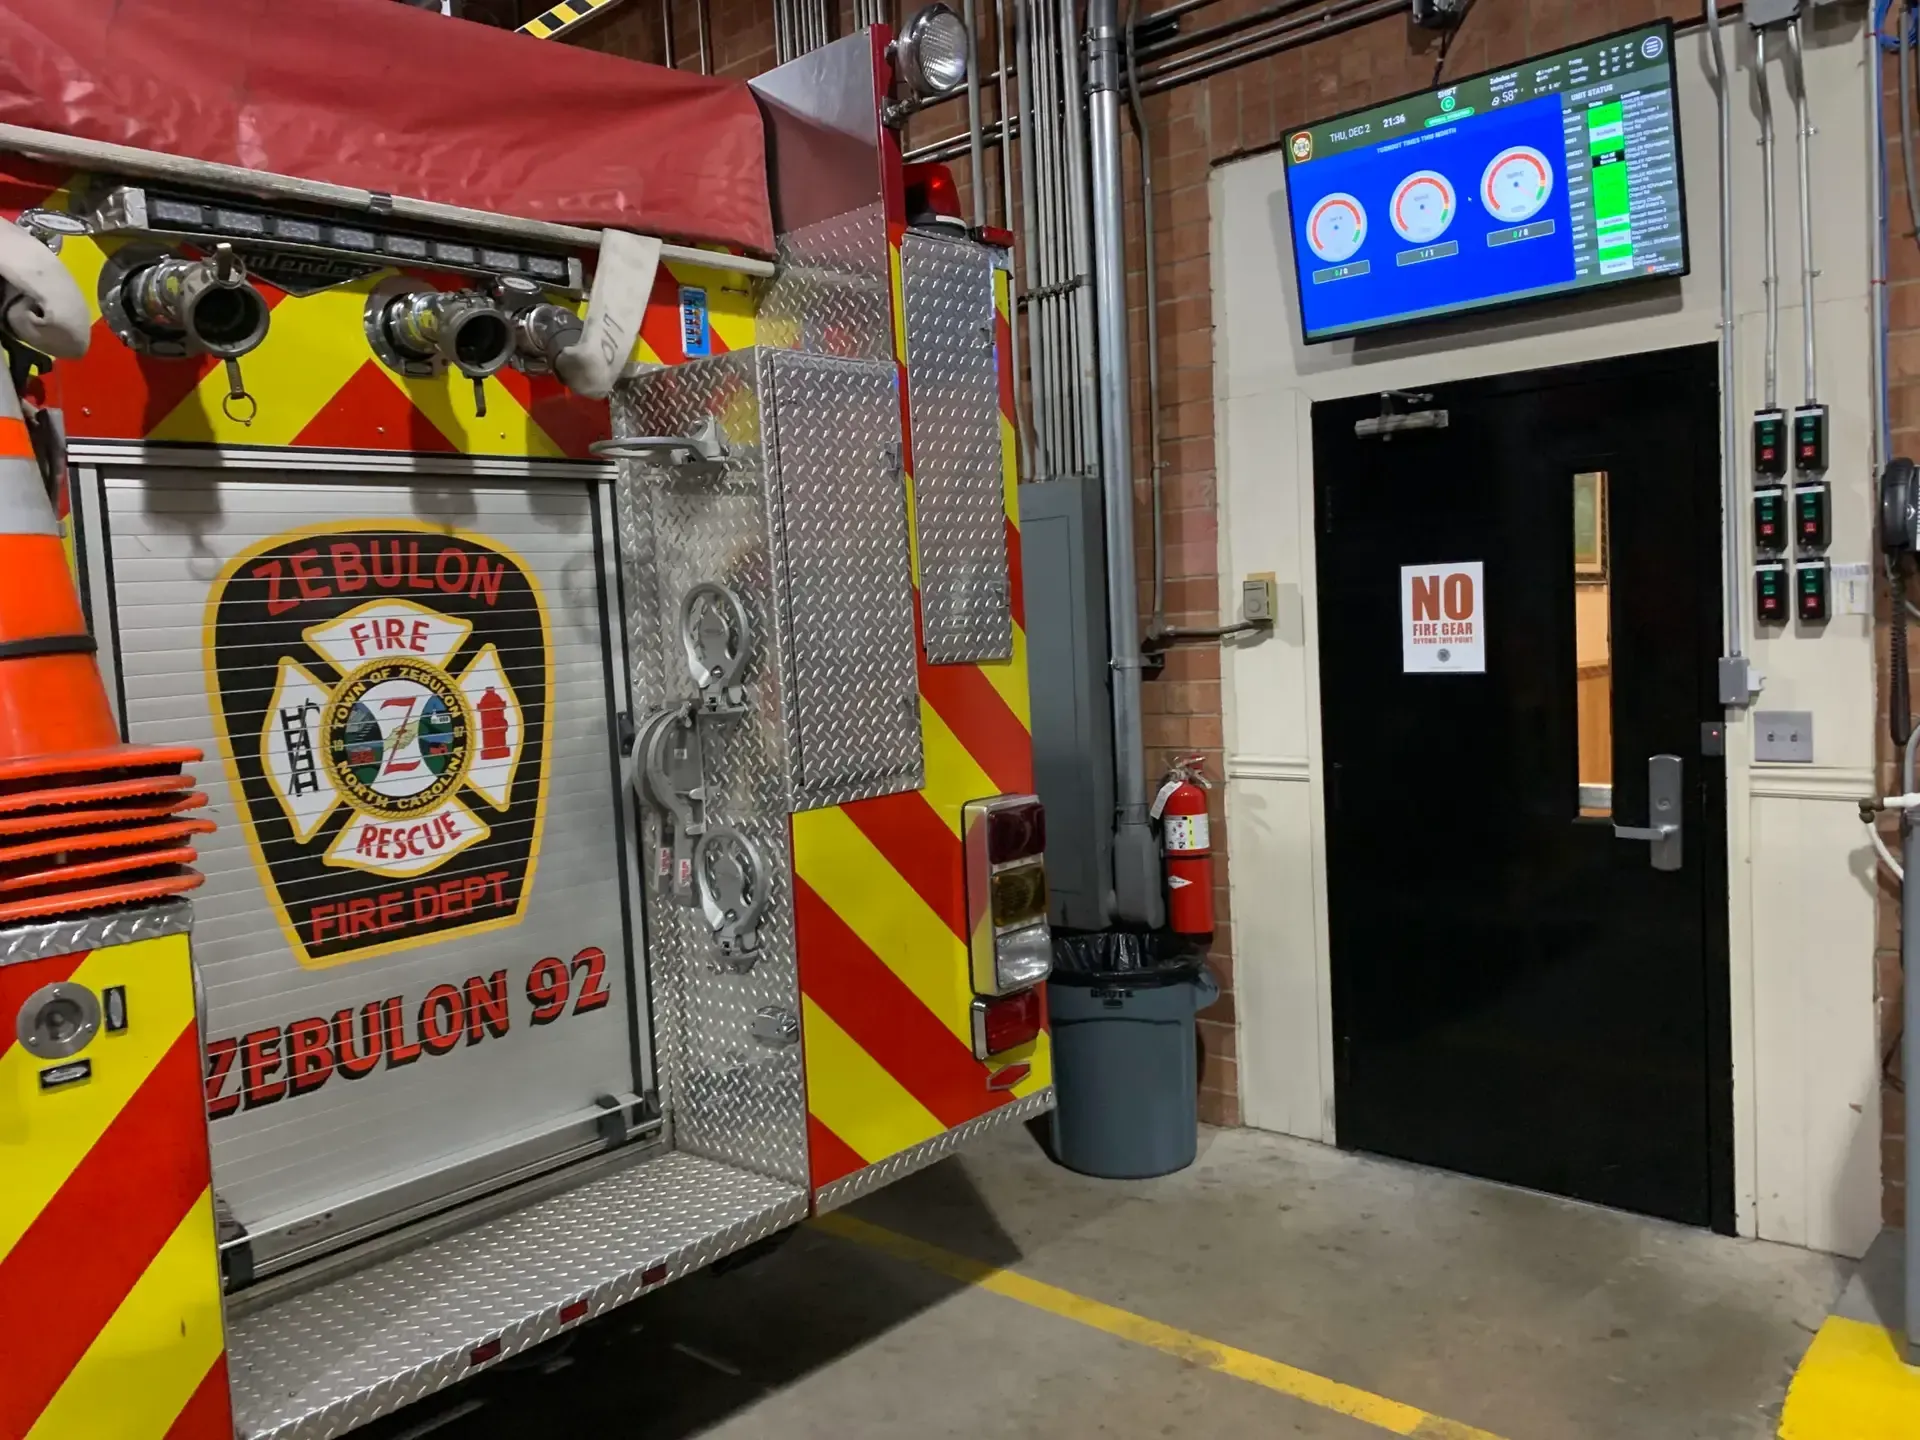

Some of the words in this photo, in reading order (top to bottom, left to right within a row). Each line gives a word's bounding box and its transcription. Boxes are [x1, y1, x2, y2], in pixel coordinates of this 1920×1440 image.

[1330, 131, 1347, 143] THU,
[1348, 127, 1363, 138] DEC
[1365, 124, 1371, 133] 2
[1382, 113, 1406, 128] 21:36
[252, 539, 504, 617] ZEBULON
[1412, 573, 1473, 621] NO
[349, 618, 430, 657] FIRE
[1413, 623, 1438, 636] FIRE
[1441, 622, 1473, 636] GEAR
[1413, 637, 1437, 645] BEYOND
[1439, 636, 1453, 644] THIS
[1455, 636, 1473, 644] POINT
[332, 682, 367, 729] TOWN
[369, 668, 392, 682] OF
[399, 667, 461, 718] ZEBULON
[380, 696, 421, 776] Z
[337, 760, 388, 808] NORTH
[397, 746, 464, 809] CAROLINA
[355, 813, 462, 860] RESCUE
[310, 890, 407, 946] FIRE
[205, 968, 509, 1121] ZEBULON
[524, 946, 611, 1028] 92
